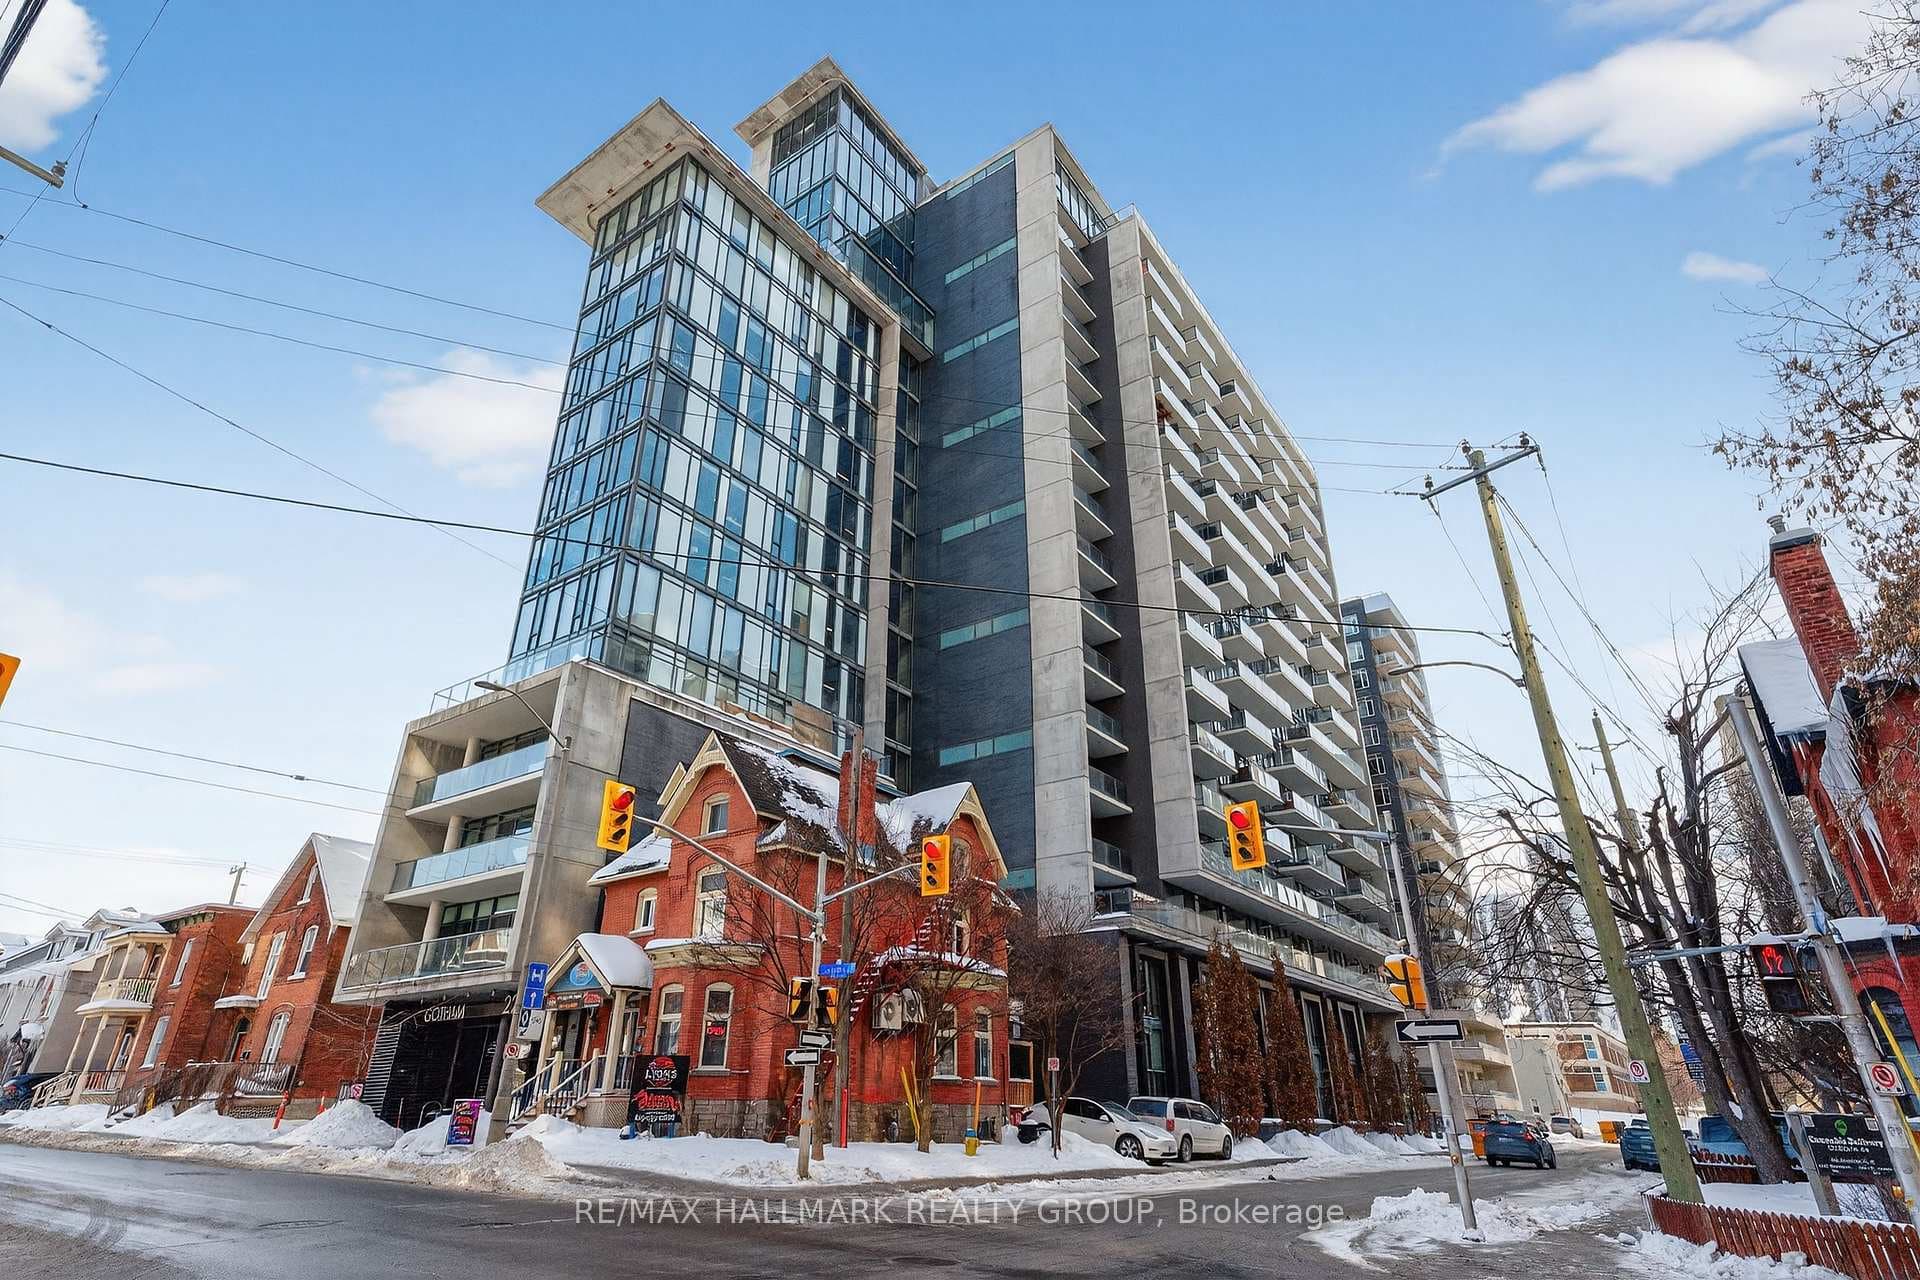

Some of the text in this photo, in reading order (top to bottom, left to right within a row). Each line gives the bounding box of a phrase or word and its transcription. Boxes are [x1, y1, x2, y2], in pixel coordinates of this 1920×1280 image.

[531, 968, 545, 983] H
[424, 1003, 466, 1023] GOTHAM
[706, 1025, 726, 1036] OPEN
